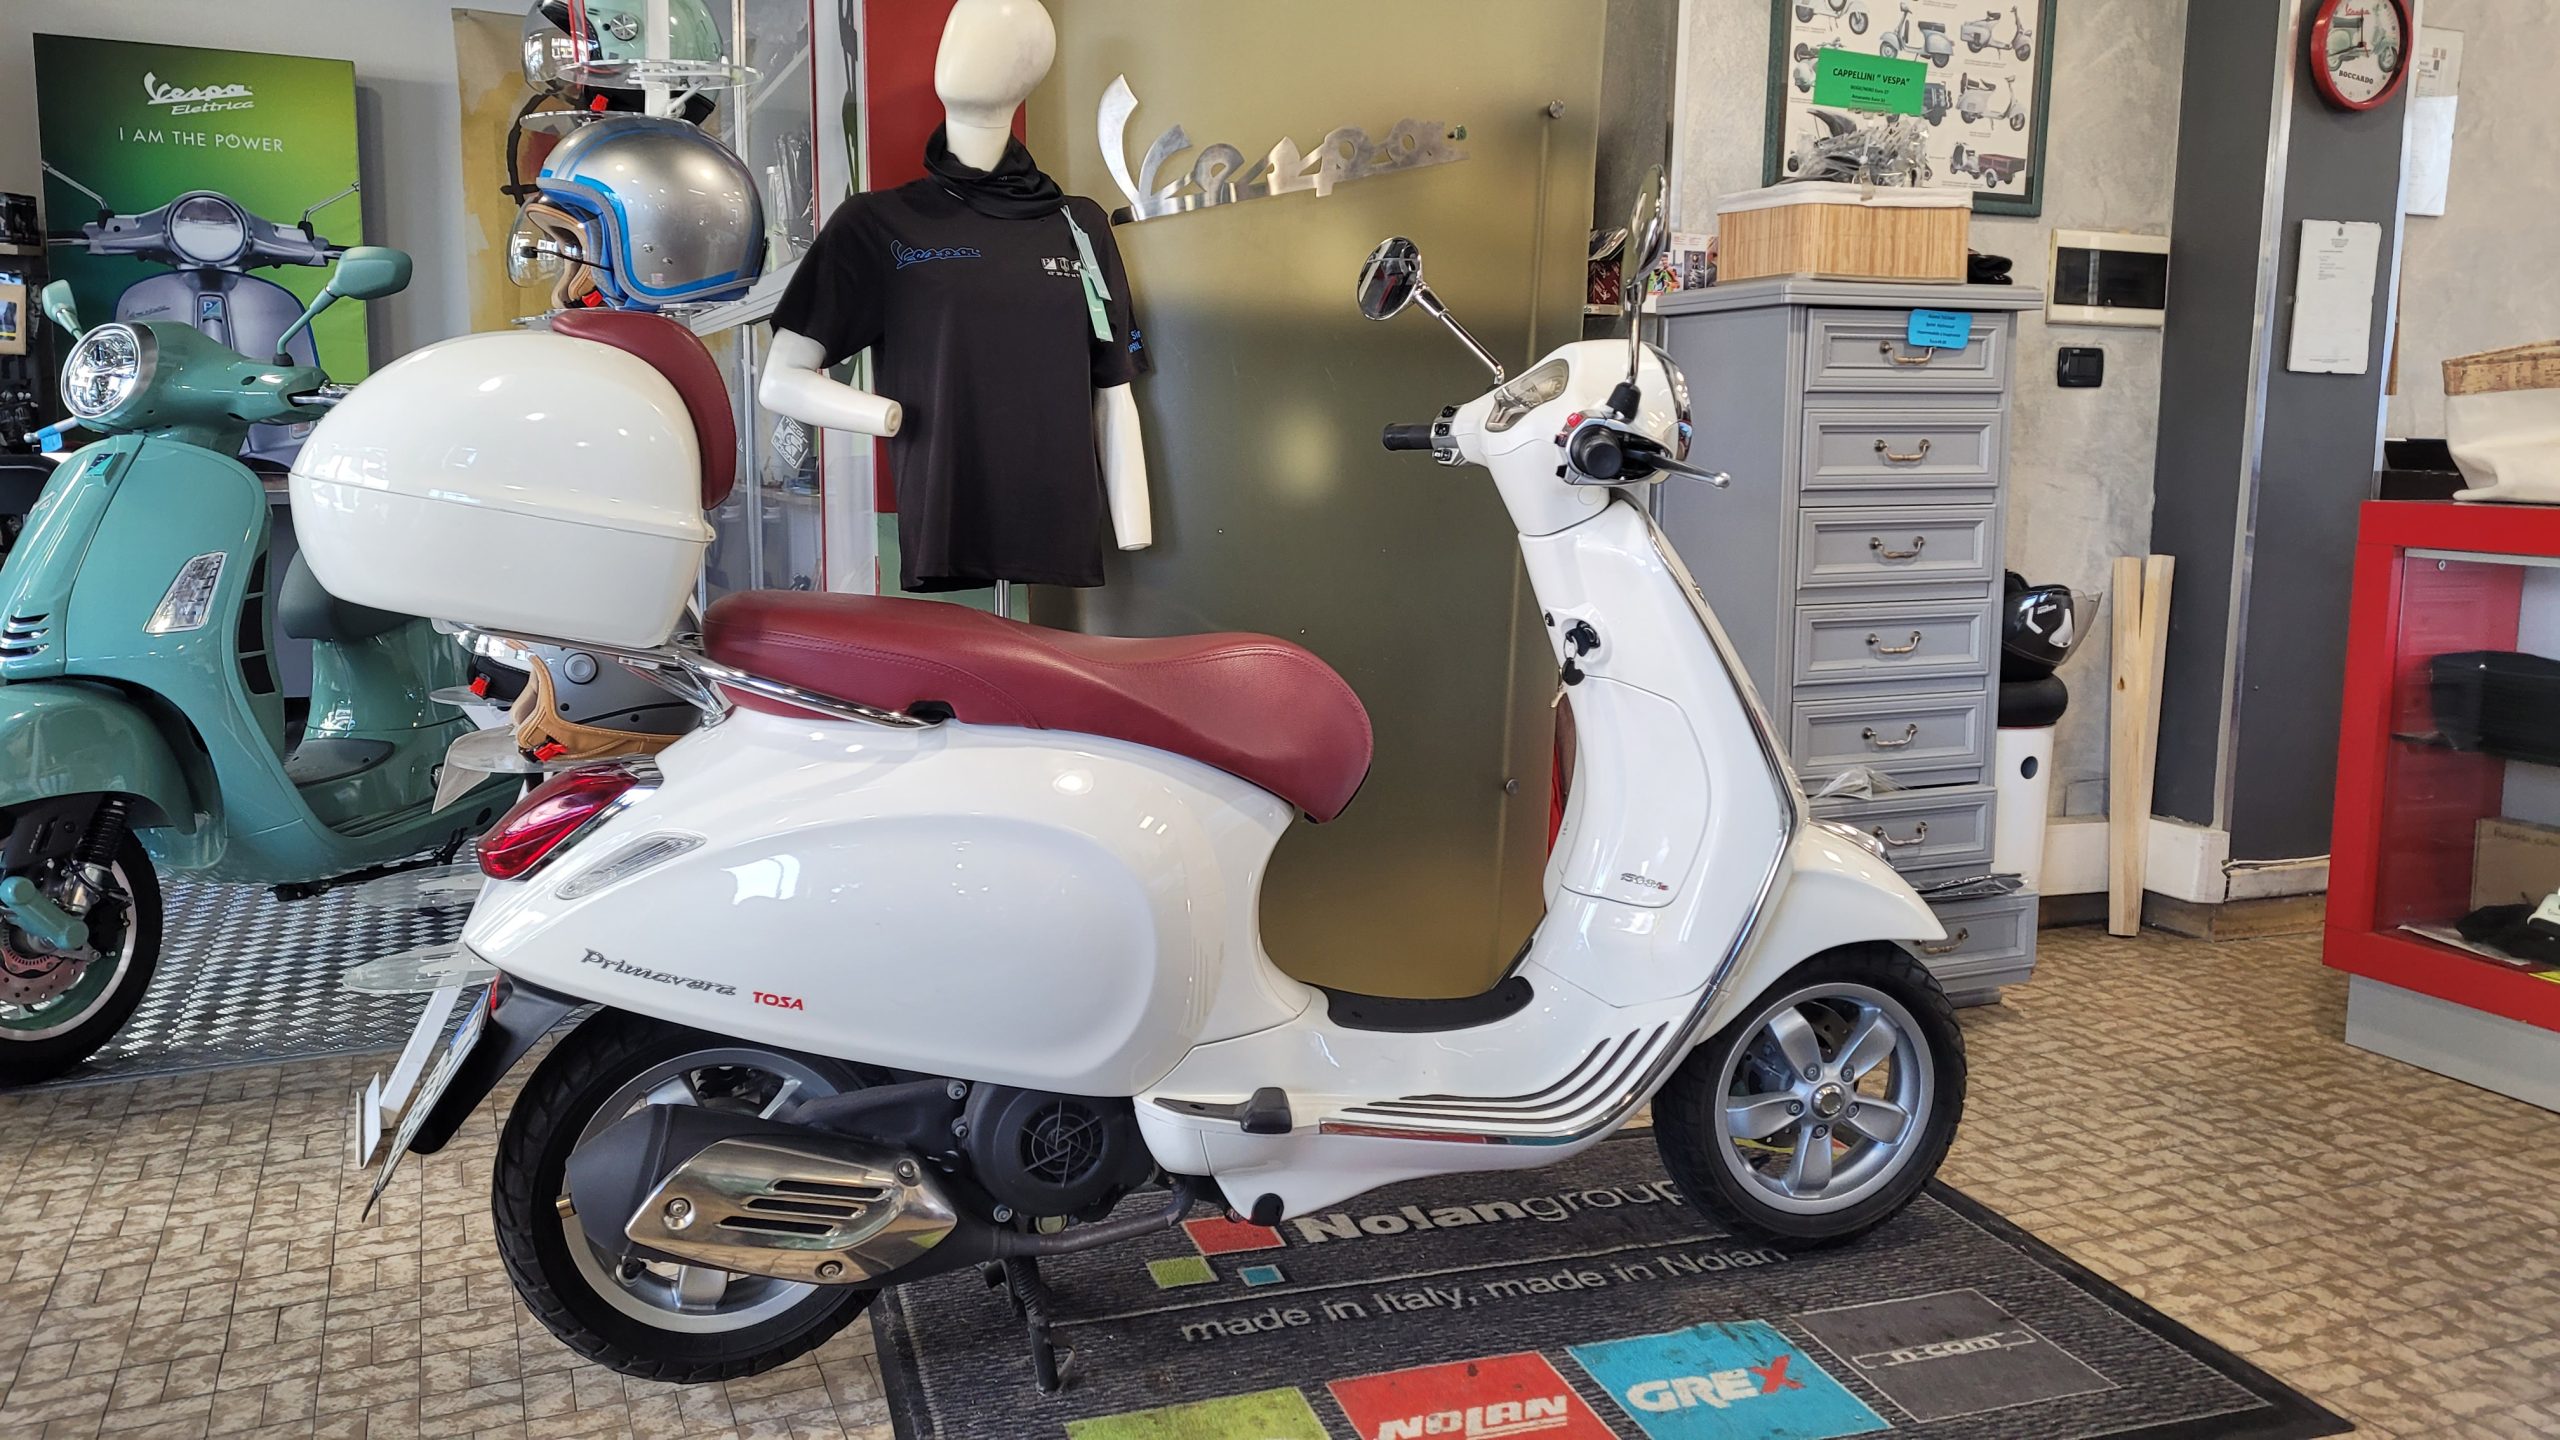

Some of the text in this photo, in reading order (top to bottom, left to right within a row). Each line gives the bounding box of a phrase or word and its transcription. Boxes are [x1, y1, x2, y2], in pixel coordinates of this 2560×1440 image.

[143, 71, 253, 105] Vespa
[1833, 67, 1875, 81] CAPPELLINI
[2338, 70, 2374, 84] BOCCARDO
[171, 101, 255, 115] Elettrica
[119, 127, 283, 152] I AM THE POWER
[1097, 73, 1470, 226] Vespa
[890, 239, 981, 270] Vespa
[581, 948, 736, 996] Primavera
[1291, 1180, 1684, 1243] Nolangroup
[1181, 1248, 1789, 1342] made in Italy, made in Nolan
[1625, 1354, 1806, 1411] GREX
[1378, 1395, 1568, 1440] NOLAN
